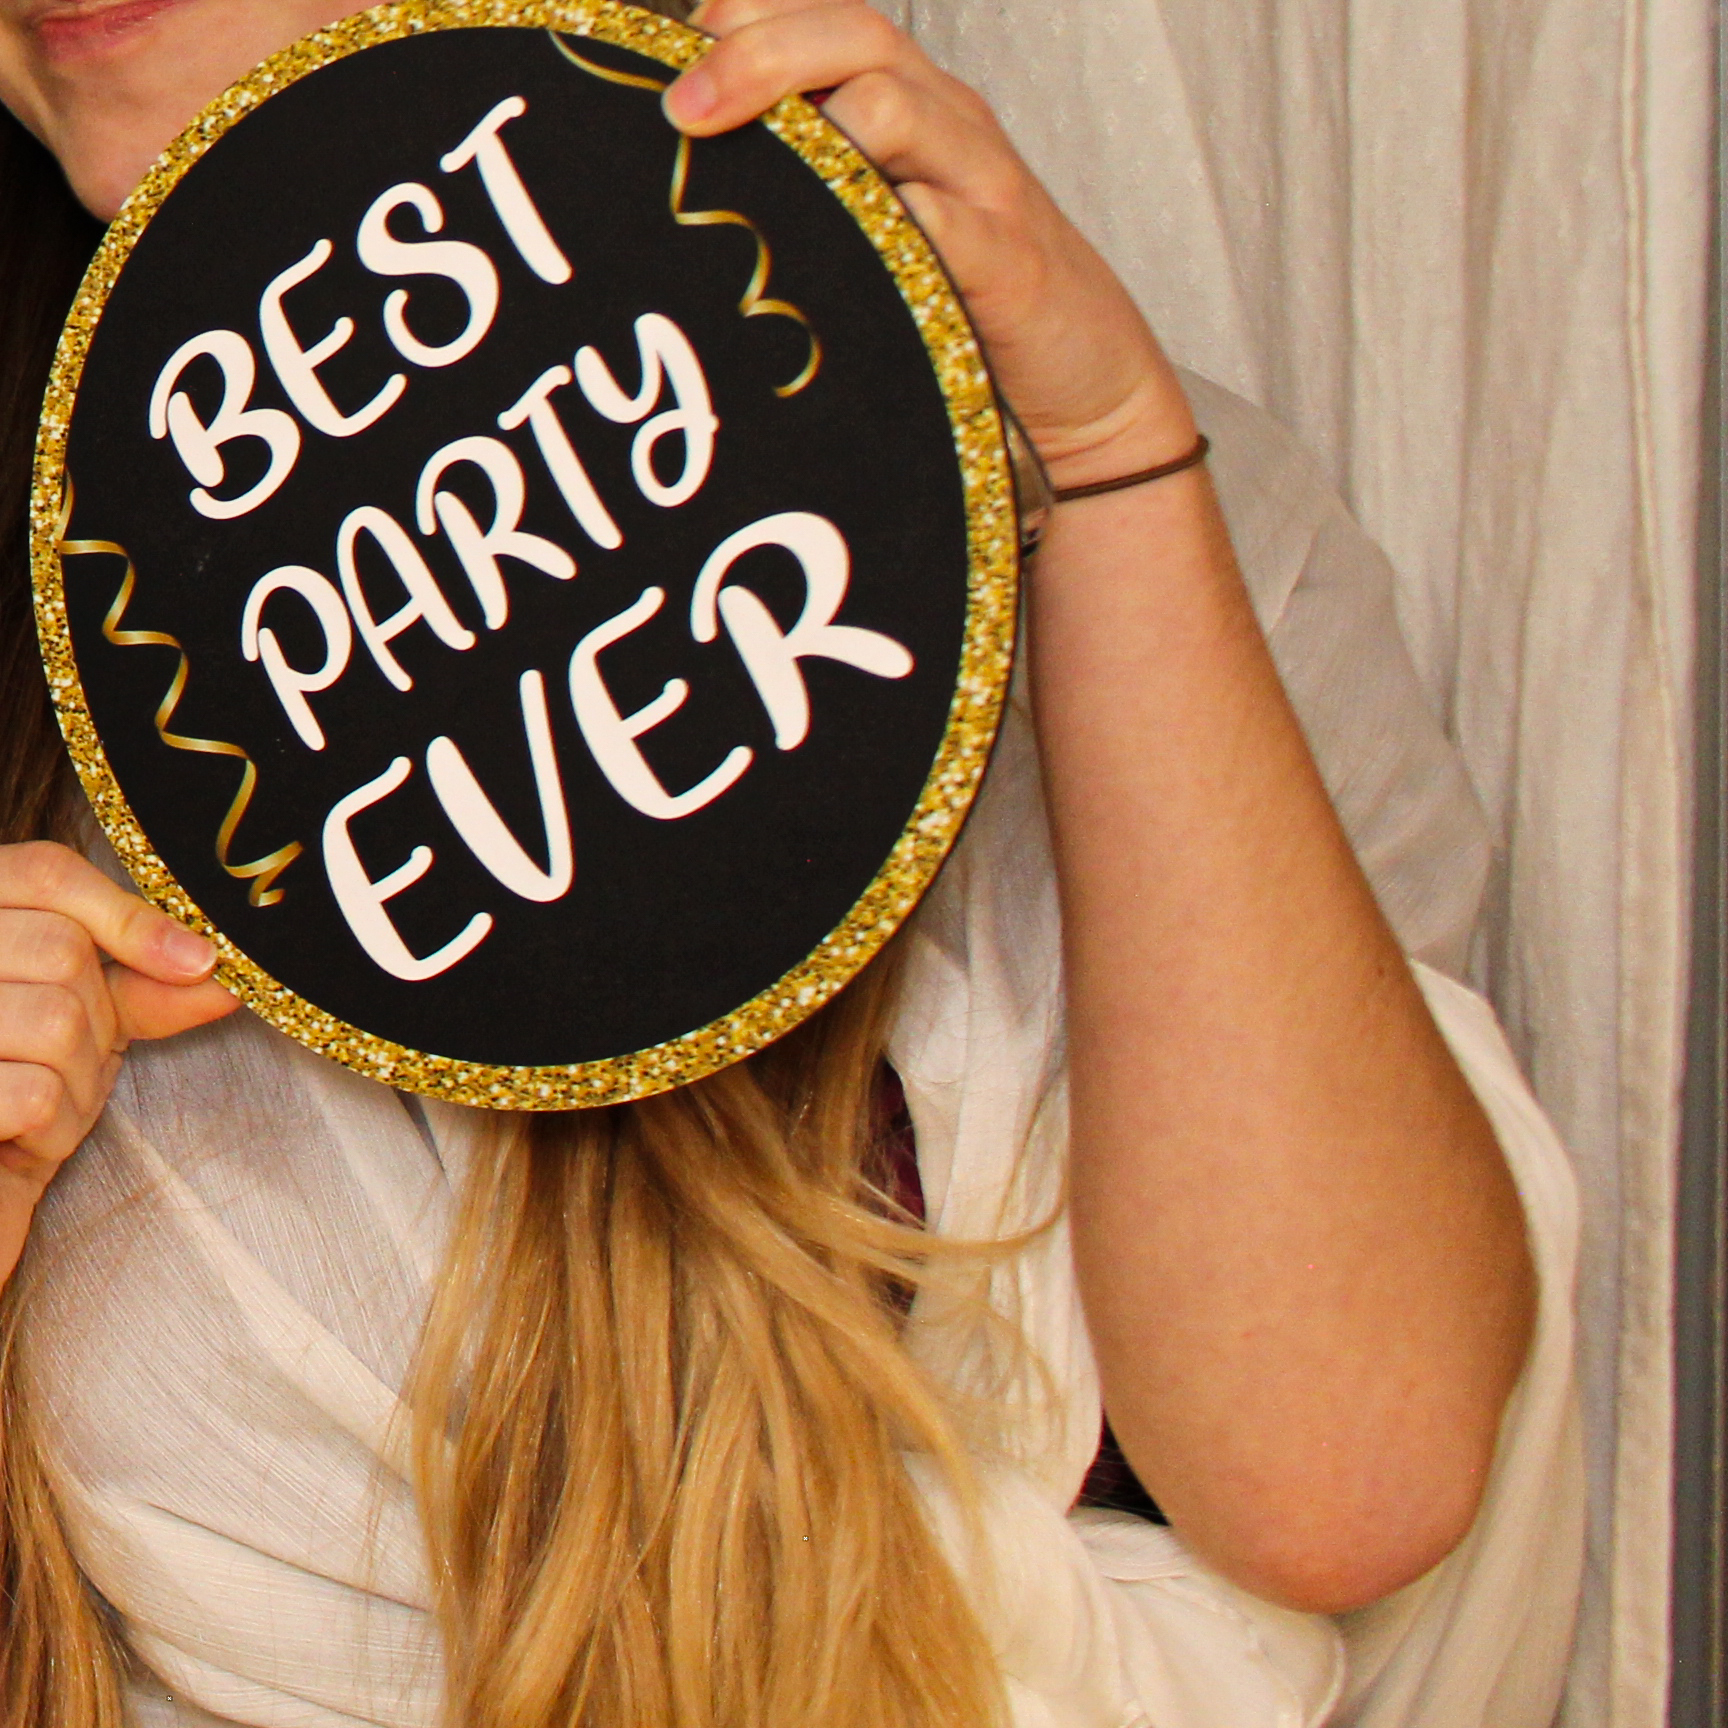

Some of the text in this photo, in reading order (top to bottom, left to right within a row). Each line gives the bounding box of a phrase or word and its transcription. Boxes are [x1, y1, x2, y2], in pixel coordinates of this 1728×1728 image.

[147, 94, 572, 521] BEST
[240, 311, 720, 753] PARTY
[321, 510, 914, 982] EVER
